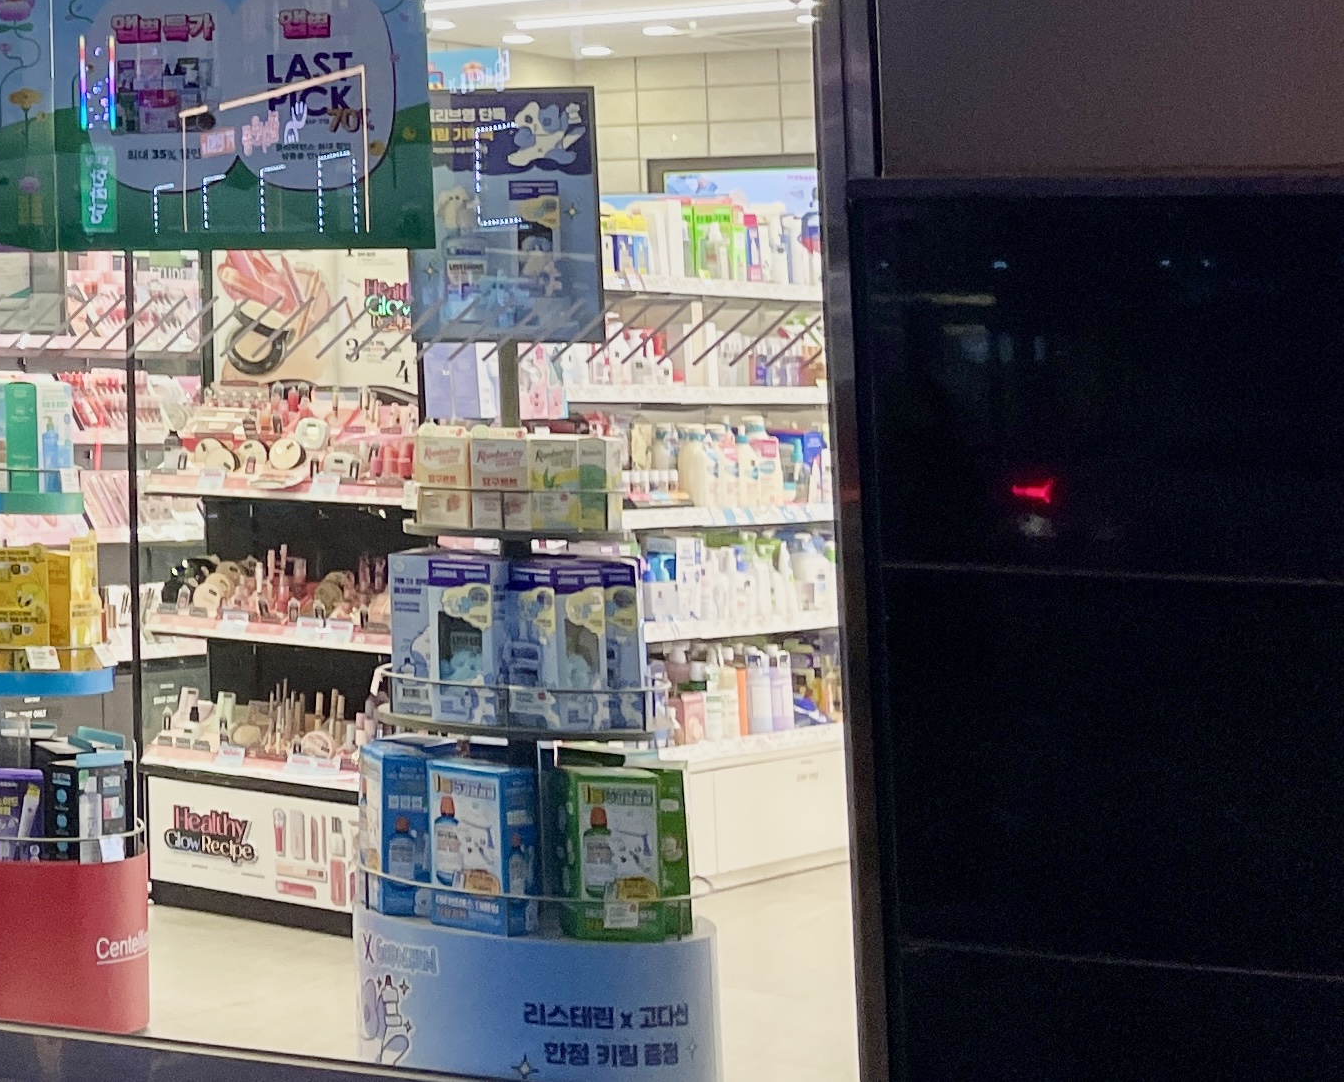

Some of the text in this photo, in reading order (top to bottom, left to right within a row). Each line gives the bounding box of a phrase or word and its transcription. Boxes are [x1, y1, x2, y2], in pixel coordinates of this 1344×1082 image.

[162, 12, 216, 43] 특가
[266, 51, 354, 84] LAST
[267, 83, 348, 118] PICK
[396, 359, 411, 384] 4
[172, 804, 249, 844] Healthy
[164, 827, 256, 863] Glow Recipe
[524, 1001, 614, 1029] 리스테린
